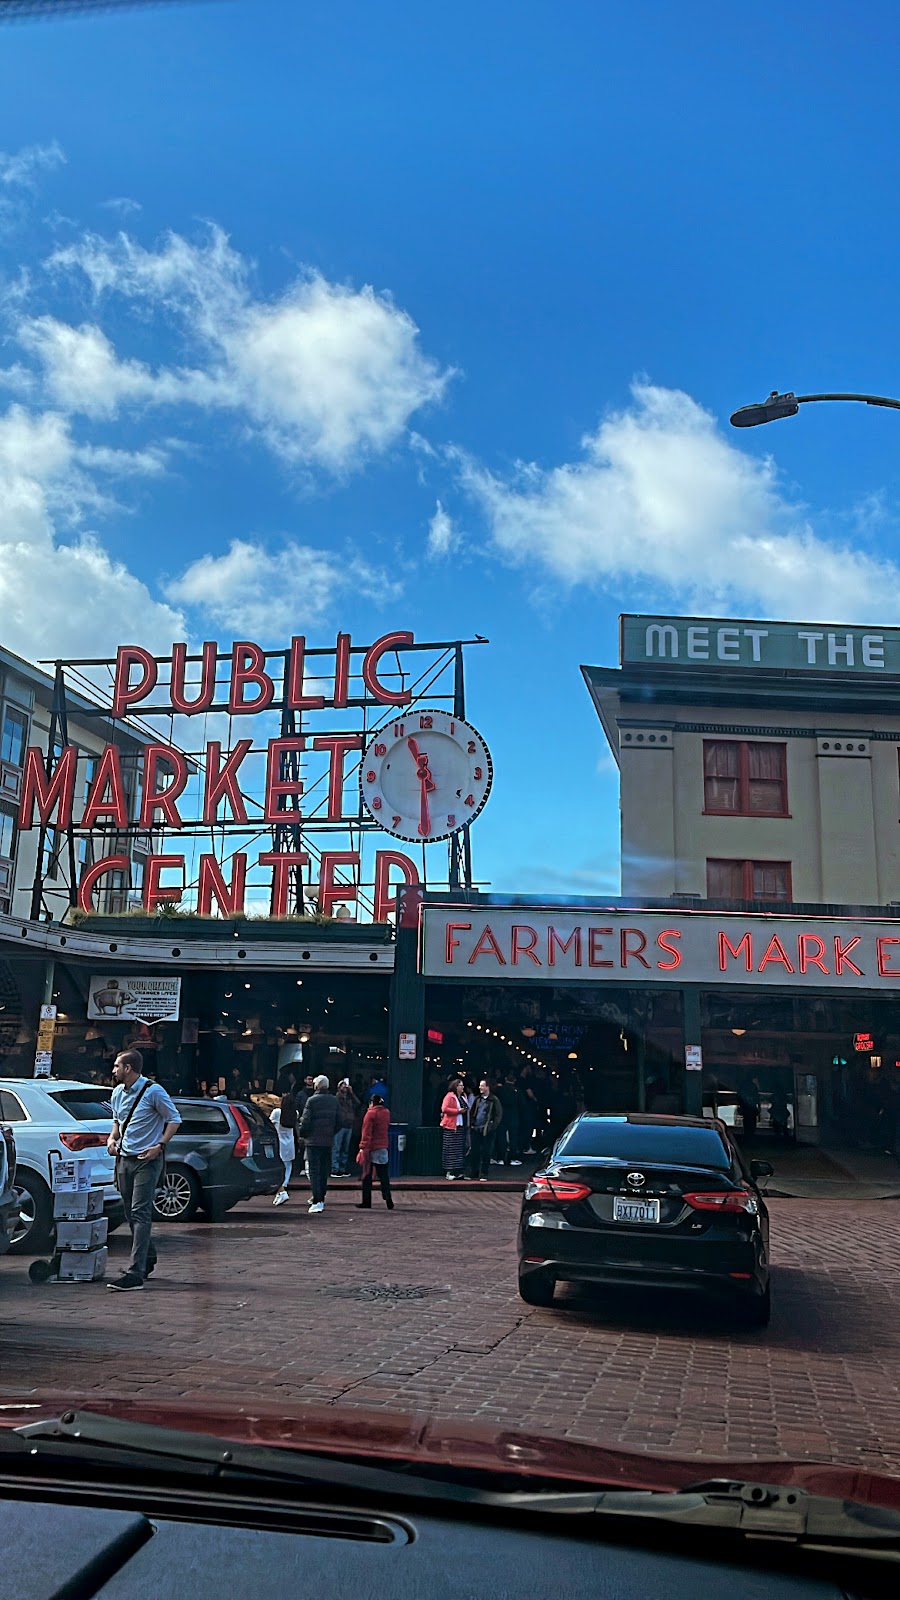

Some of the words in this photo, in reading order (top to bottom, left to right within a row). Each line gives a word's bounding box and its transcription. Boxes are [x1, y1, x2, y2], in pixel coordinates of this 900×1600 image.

[645, 623, 768, 662] MEET
[797, 631, 885, 668] THE
[112, 631, 414, 719] PUBLIC
[419, 716, 433, 729] 12
[450, 722, 455, 735] 1
[394, 724, 405, 737] 11
[374, 744, 387, 756] 10
[467, 740, 476, 753] 2
[366, 771, 376, 782] 9
[474, 767, 483, 780] 3
[18, 736, 363, 830] MARKET
[372, 797, 382, 809] 8
[464, 794, 475, 807] 4
[391, 816, 402, 828] 7
[446, 815, 456, 828] 5
[78, 850, 420, 922] CENTER
[445, 922, 682, 970] FARMERS
[718, 931, 900, 976] MARKE
